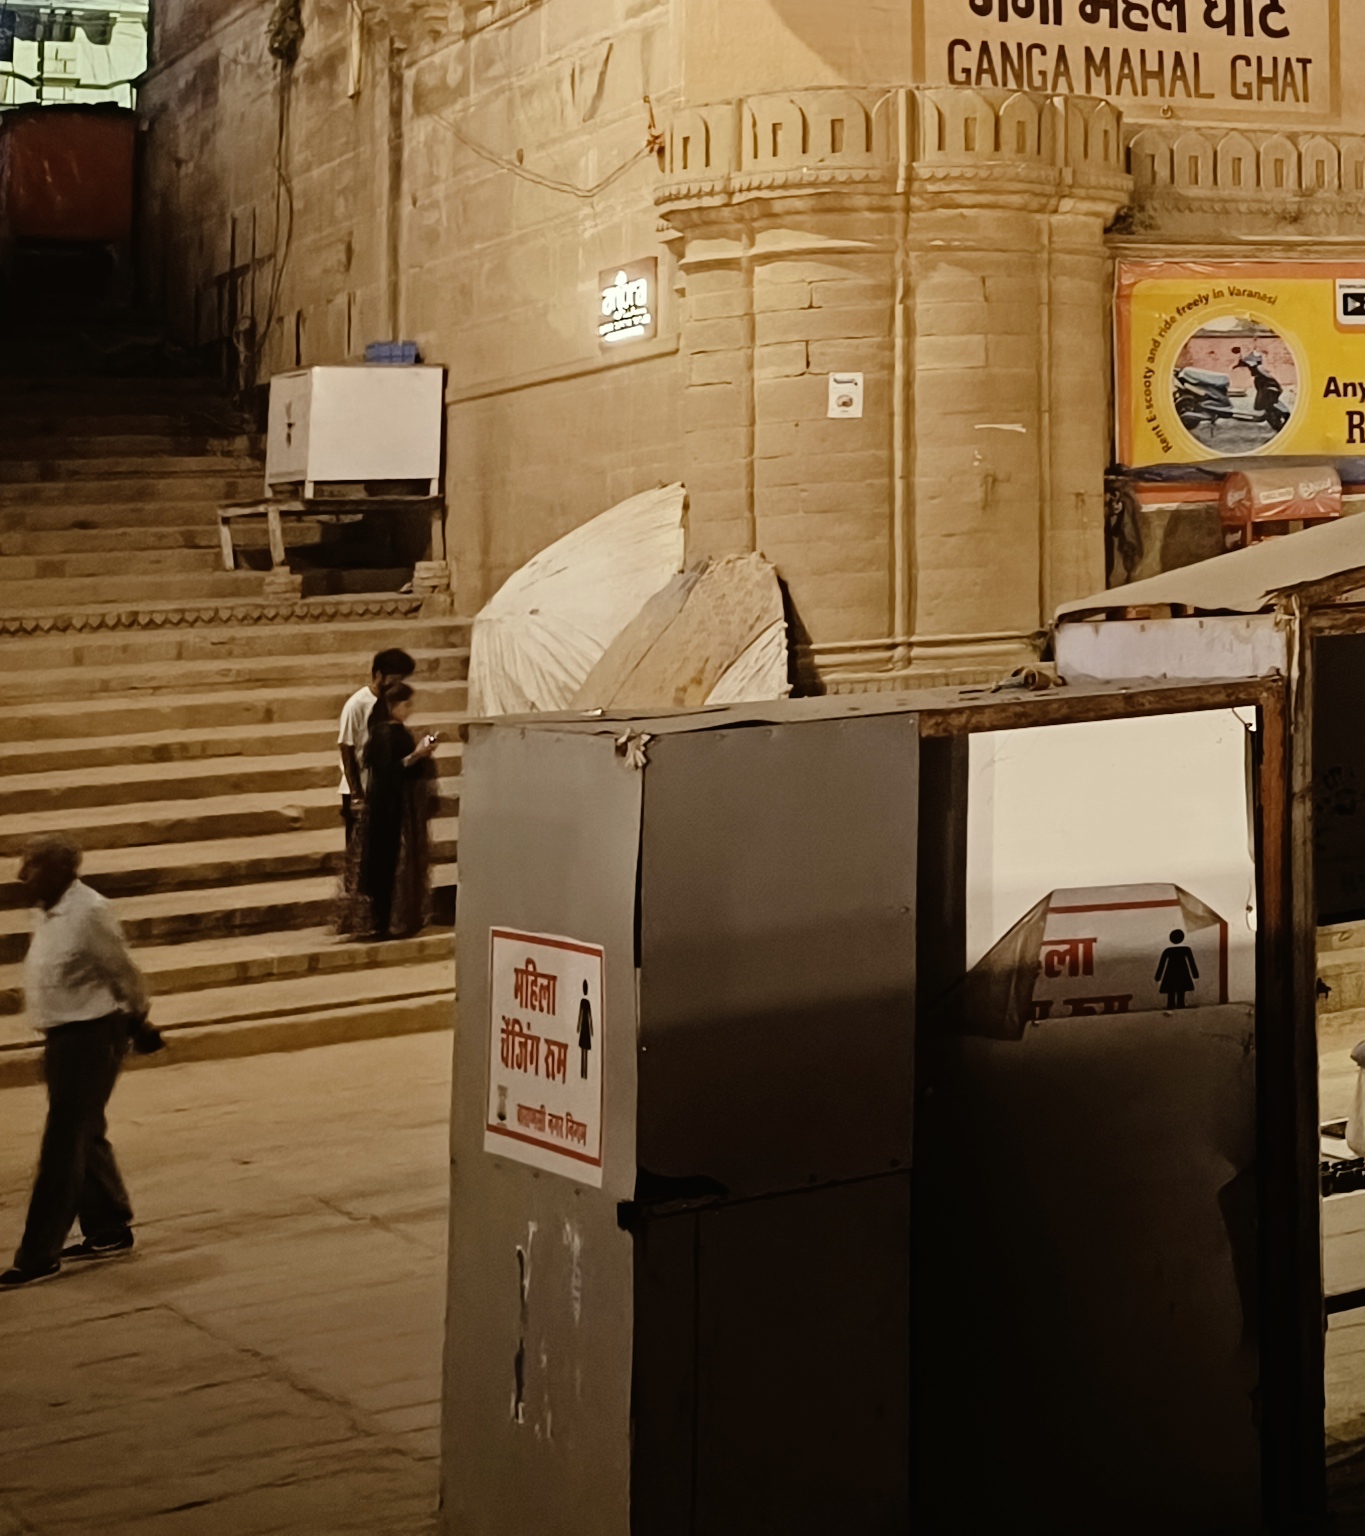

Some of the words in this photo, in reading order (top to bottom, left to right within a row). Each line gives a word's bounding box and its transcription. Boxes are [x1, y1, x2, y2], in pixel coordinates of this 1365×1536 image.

[948, 38, 1075, 93] GANGA
[1084, 46, 1215, 98] MAHAL
[1230, 54, 1312, 103] GHAT
[1175, 293, 1211, 317] freely
[1212, 288, 1225, 300] in
[1227, 285, 1279, 306] Varanasi
[1158, 315, 1177, 339] ride
[1146, 337, 1162, 364] and
[1151, 423, 1174, 454] Rent
[513, 957, 557, 1016] महिला
[544, 1037, 569, 1085] रूम
